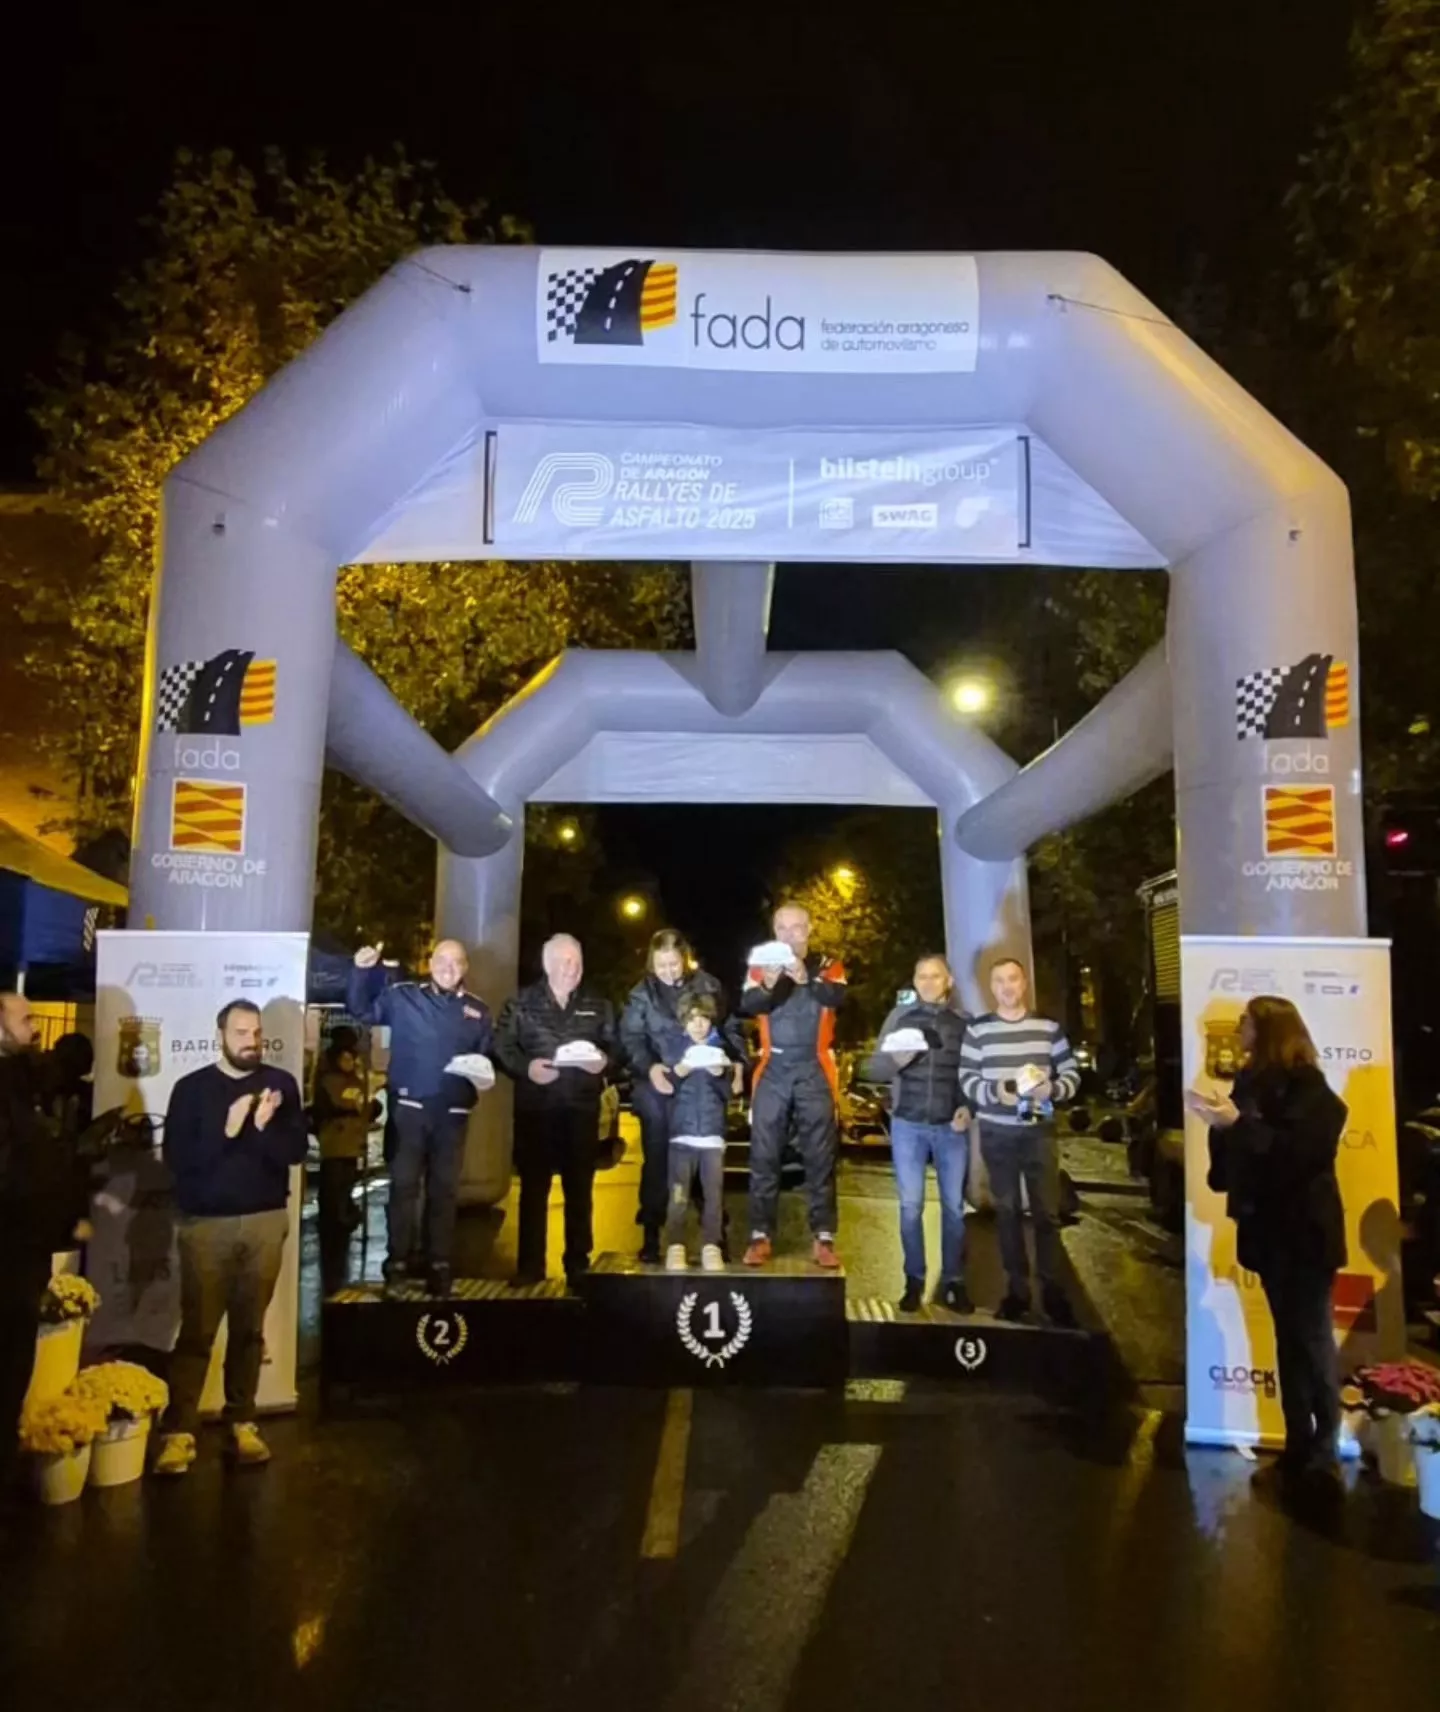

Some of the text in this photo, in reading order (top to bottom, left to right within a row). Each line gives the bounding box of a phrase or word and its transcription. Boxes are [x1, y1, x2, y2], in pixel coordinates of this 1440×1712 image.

[690, 293, 805, 350] fada
[821, 318, 893, 335] federación
[821, 338, 838, 351] de
[621, 452, 723, 467] CAMPEONATO
[621, 467, 638, 480] DE
[613, 481, 737, 504] RALLYES DE
[609, 506, 756, 529] ASFALTO 2025
[876, 509, 933, 523] SWAG
[174, 739, 241, 769] fada
[151, 853, 267, 875] GOBIERNO DE
[1335, 861, 1352, 876] DE
[702, 1302, 726, 1339] 1
[433, 1319, 450, 1346] 2
[964, 1341, 976, 1359] 3
